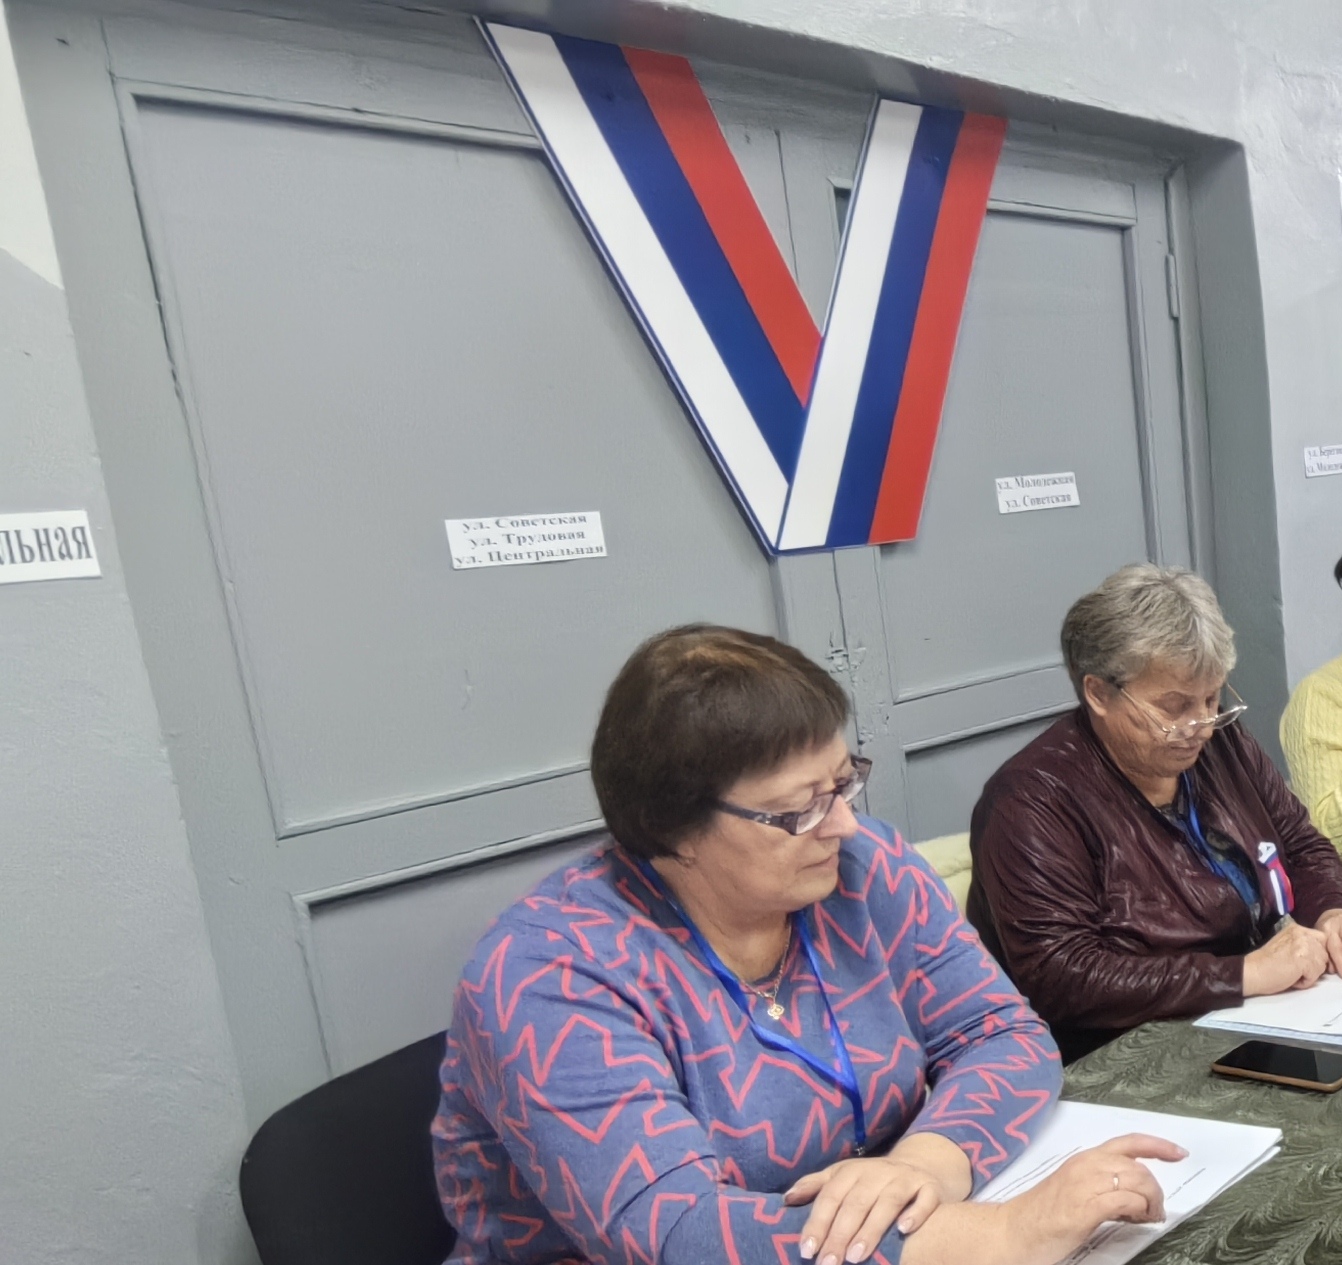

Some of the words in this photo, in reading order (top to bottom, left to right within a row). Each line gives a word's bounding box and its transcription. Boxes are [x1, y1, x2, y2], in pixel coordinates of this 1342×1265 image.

[462, 522, 490, 534] ул.
[495, 515, 587, 529] Советская
[468, 537, 497, 549] ул.
[502, 531, 586, 546] Трудовая
[454, 555, 482, 568] ул.
[487, 545, 604, 562] Центральная
